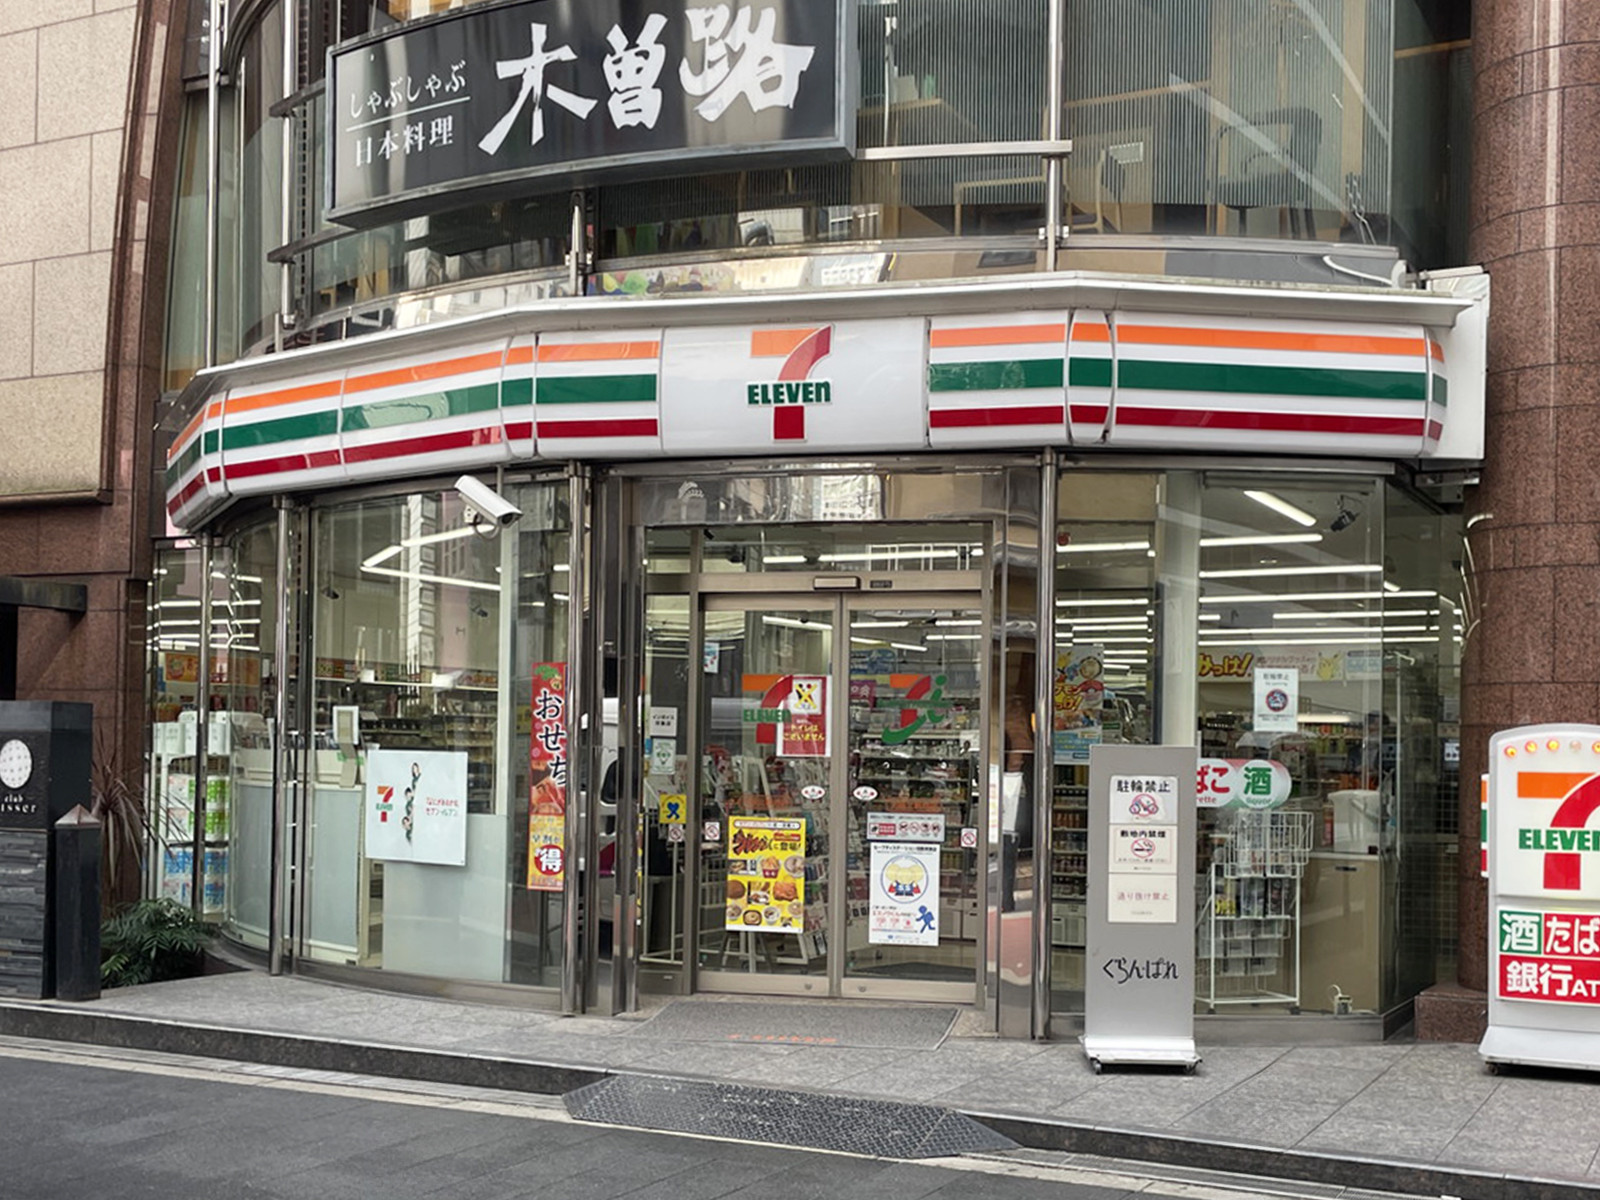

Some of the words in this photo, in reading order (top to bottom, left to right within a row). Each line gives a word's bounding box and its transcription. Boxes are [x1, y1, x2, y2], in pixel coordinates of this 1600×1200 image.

[349, 59, 468, 119] しゃぶしゃぶ
[478, 4, 816, 155] 木曽路
[355, 115, 454, 168] 日本料理
[751, 325, 831, 440] 7
[533, 690, 567, 786] おせち
[1116, 780, 1171, 792] 駐輪禁止
[1244, 766, 1272, 795] 酒
[1120, 830, 1166, 838] 敷地内禁煙
[1117, 891, 1169, 900] 通り抜け禁止
[1502, 913, 1541, 952] 酒
